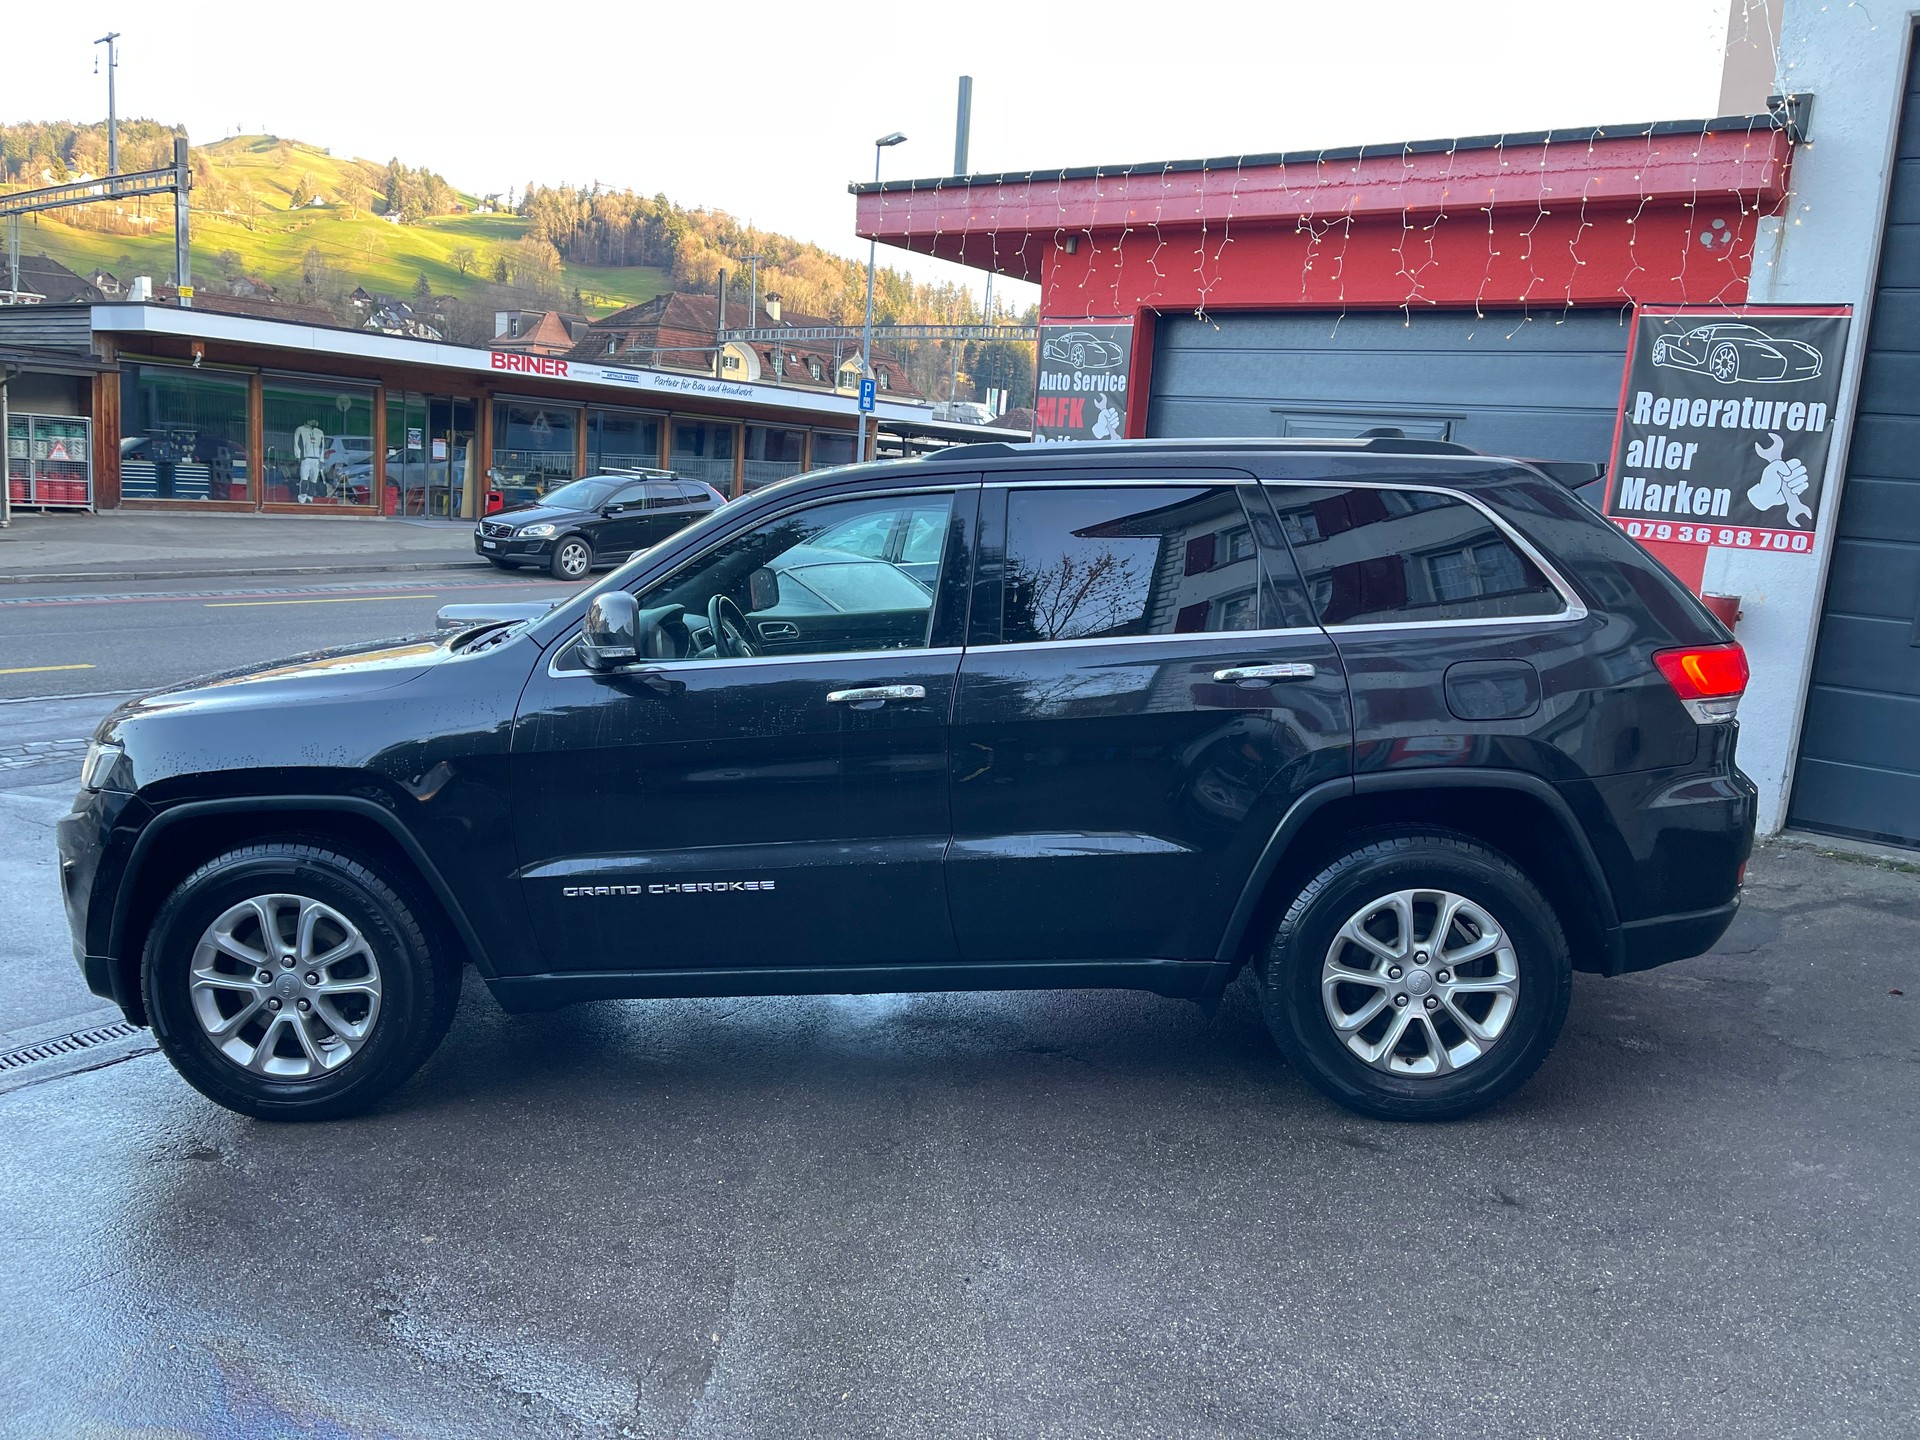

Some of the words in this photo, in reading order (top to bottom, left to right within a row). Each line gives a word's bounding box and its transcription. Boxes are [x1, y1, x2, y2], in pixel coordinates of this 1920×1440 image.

[491, 352, 568, 377] BRINER
[654, 376, 679, 387] Partner
[680, 378, 690, 390] für
[692, 381, 705, 391] Bau
[707, 383, 721, 392] und
[721, 385, 754, 397] Handwerk
[864, 382, 872, 397] P
[1039, 371, 1071, 391] Auto
[1073, 371, 1126, 392] Service
[1036, 396, 1085, 429] MFK
[1632, 391, 1828, 432] Reperaturen
[1625, 435, 1699, 471] aller
[1619, 476, 1732, 517] Marken
[1627, 522, 1672, 540] 079
[1678, 526, 1711, 543] 36
[1718, 529, 1752, 546] 98
[1759, 532, 1808, 551] 700
[563, 885, 642, 897] GRAND
[648, 880, 776, 894] CHEROKEE
